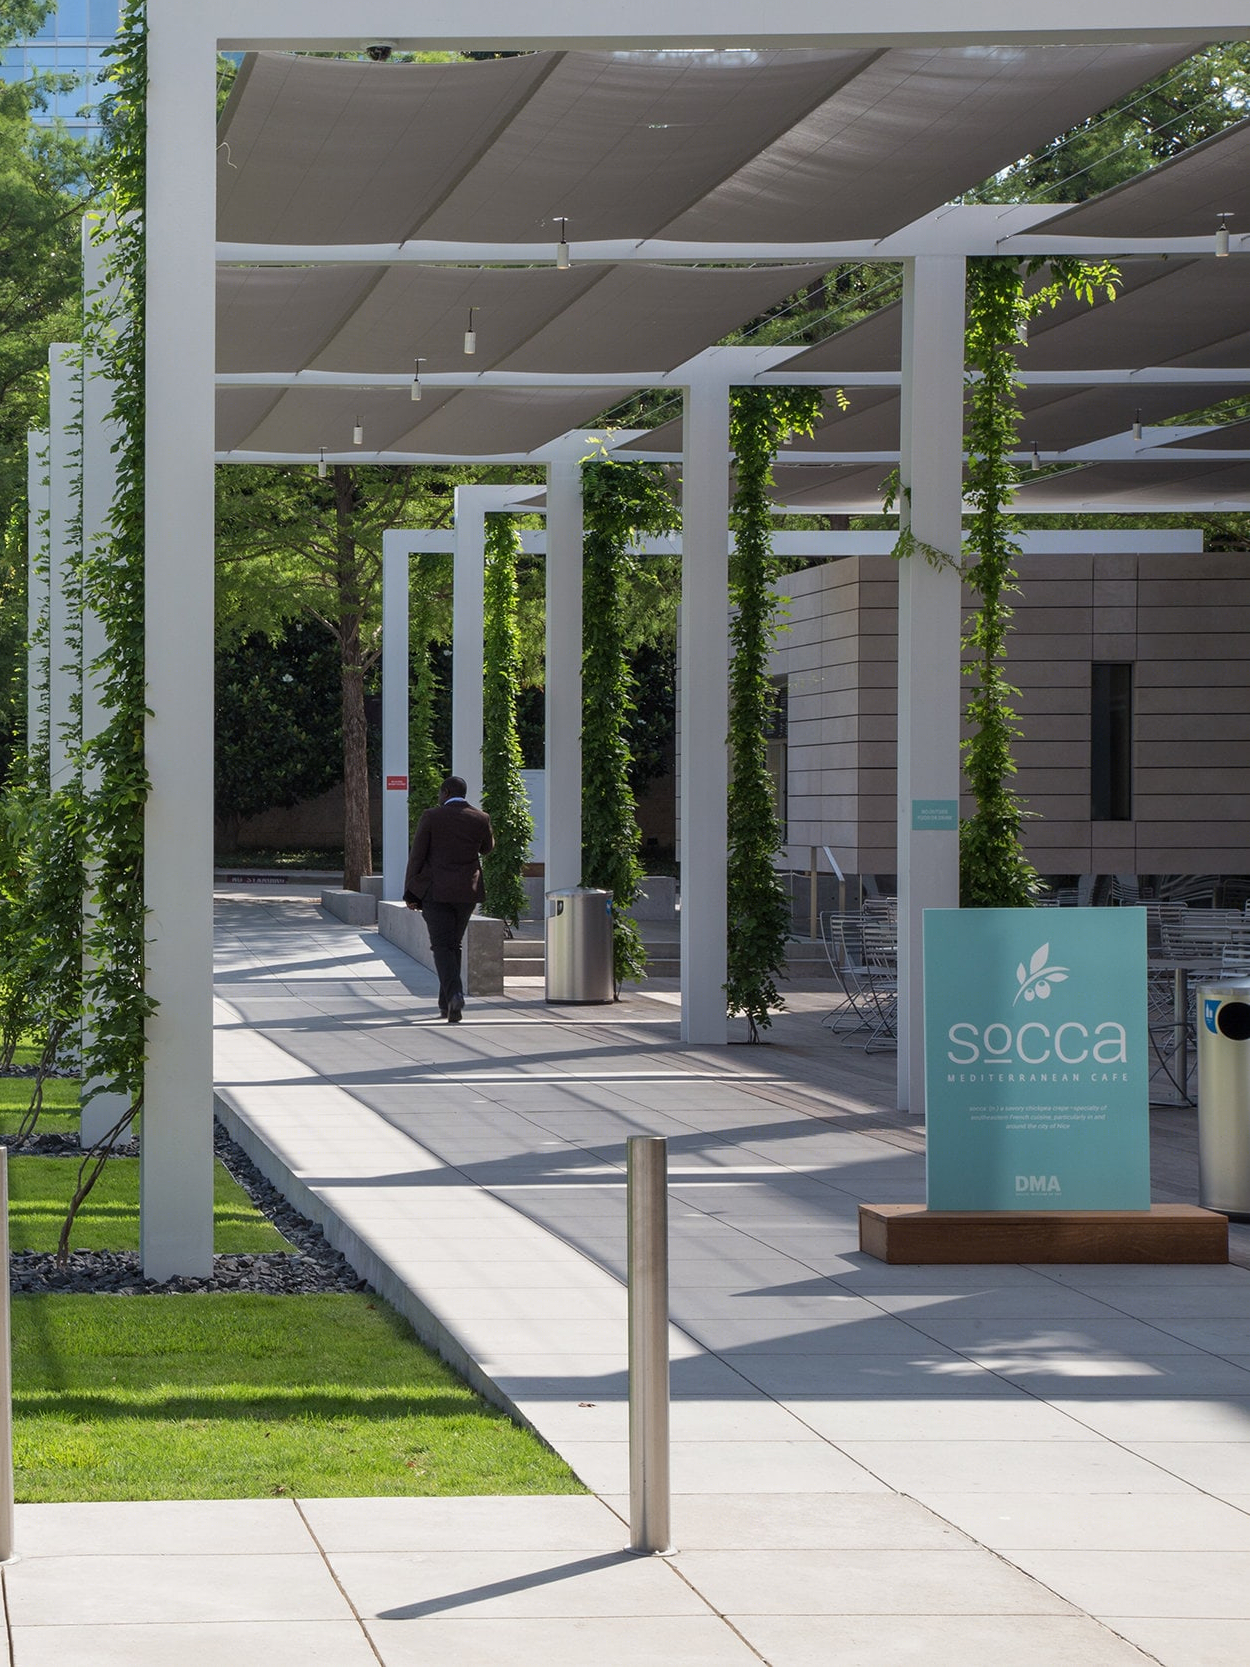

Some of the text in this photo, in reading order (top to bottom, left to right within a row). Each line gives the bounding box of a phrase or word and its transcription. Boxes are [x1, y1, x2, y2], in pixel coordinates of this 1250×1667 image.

[947, 1021, 1127, 1065] socca
[947, 1073, 1129, 1082] MEDITERRANEAN CAFE
[1005, 1105, 1024, 1113] savory
[1009, 1113, 1030, 1121] French
[1037, 1123, 1048, 1131] city
[1015, 1175, 1062, 1192] DMA
